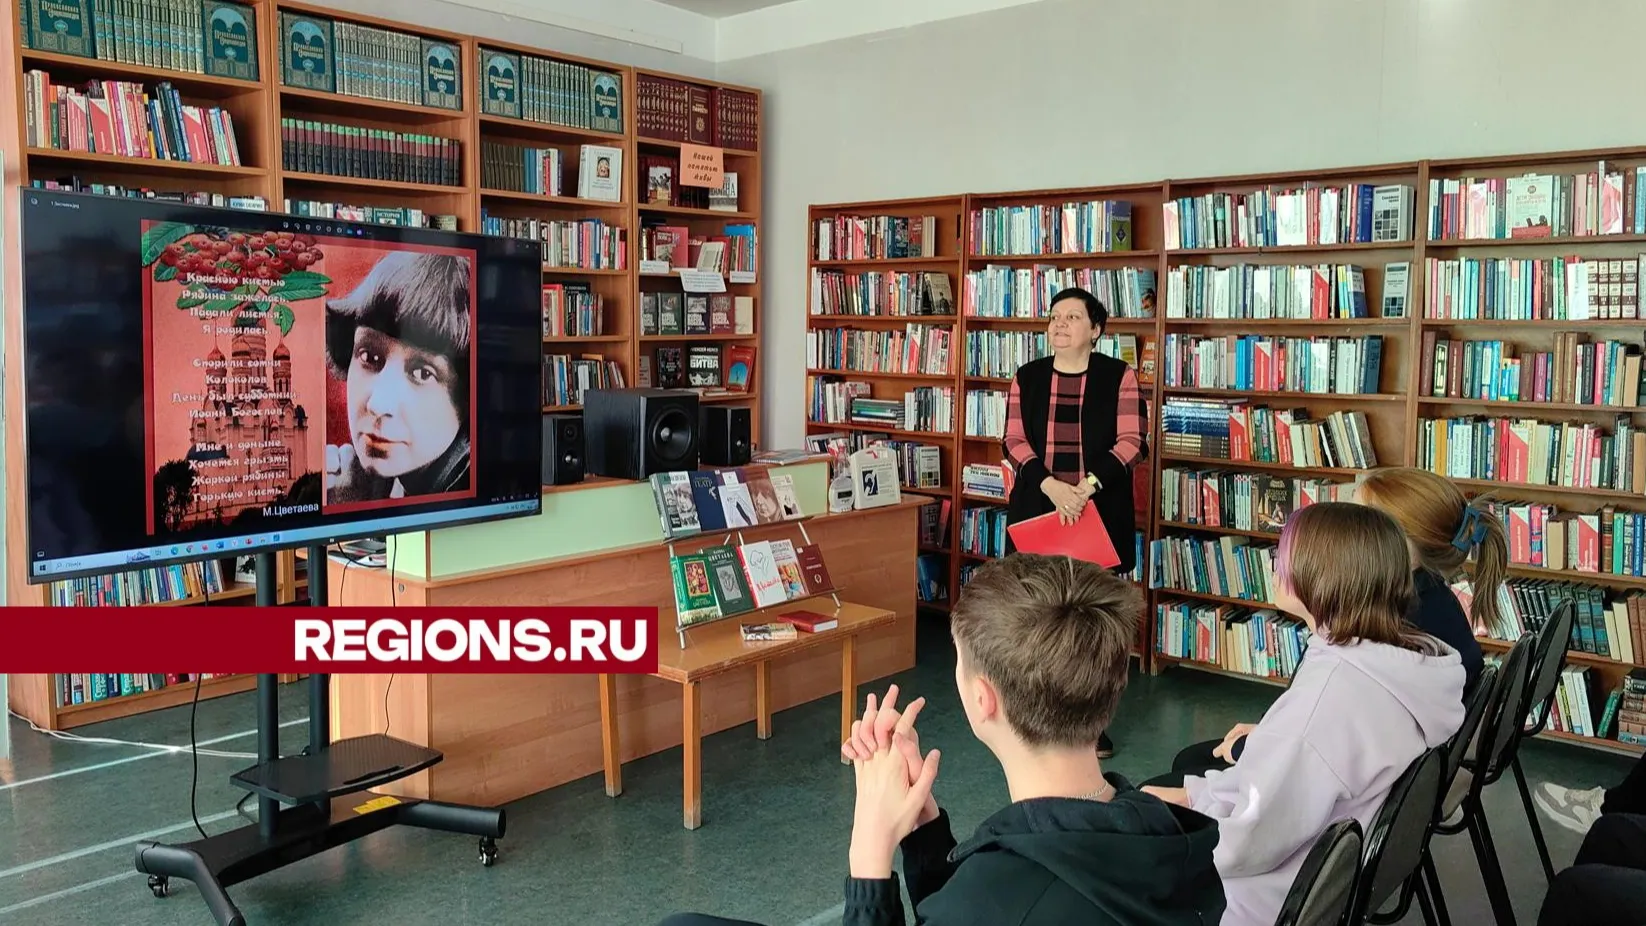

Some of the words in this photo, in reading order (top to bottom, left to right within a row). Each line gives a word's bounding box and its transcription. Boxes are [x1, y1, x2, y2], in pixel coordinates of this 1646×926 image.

[186, 272, 238, 285] Красною
[242, 277, 286, 287] кистью
[182, 289, 226, 300] Рябина
[190, 307, 233, 318] Падали
[202, 325, 211, 334] Я
[192, 358, 243, 369] Спорили
[247, 359, 281, 368] сотни
[690, 359, 718, 369] БИТВА
[171, 392, 204, 403] День
[208, 389, 235, 403] был
[189, 408, 226, 418] Иоанн
[195, 442, 222, 453] Мне
[226, 442, 233, 450] и
[188, 457, 239, 470] Хочется
[191, 475, 238, 487] Жаркой
[242, 470, 286, 484] рябины
[193, 491, 243, 503] Горькую
[263, 502, 319, 518] М.Цветаева
